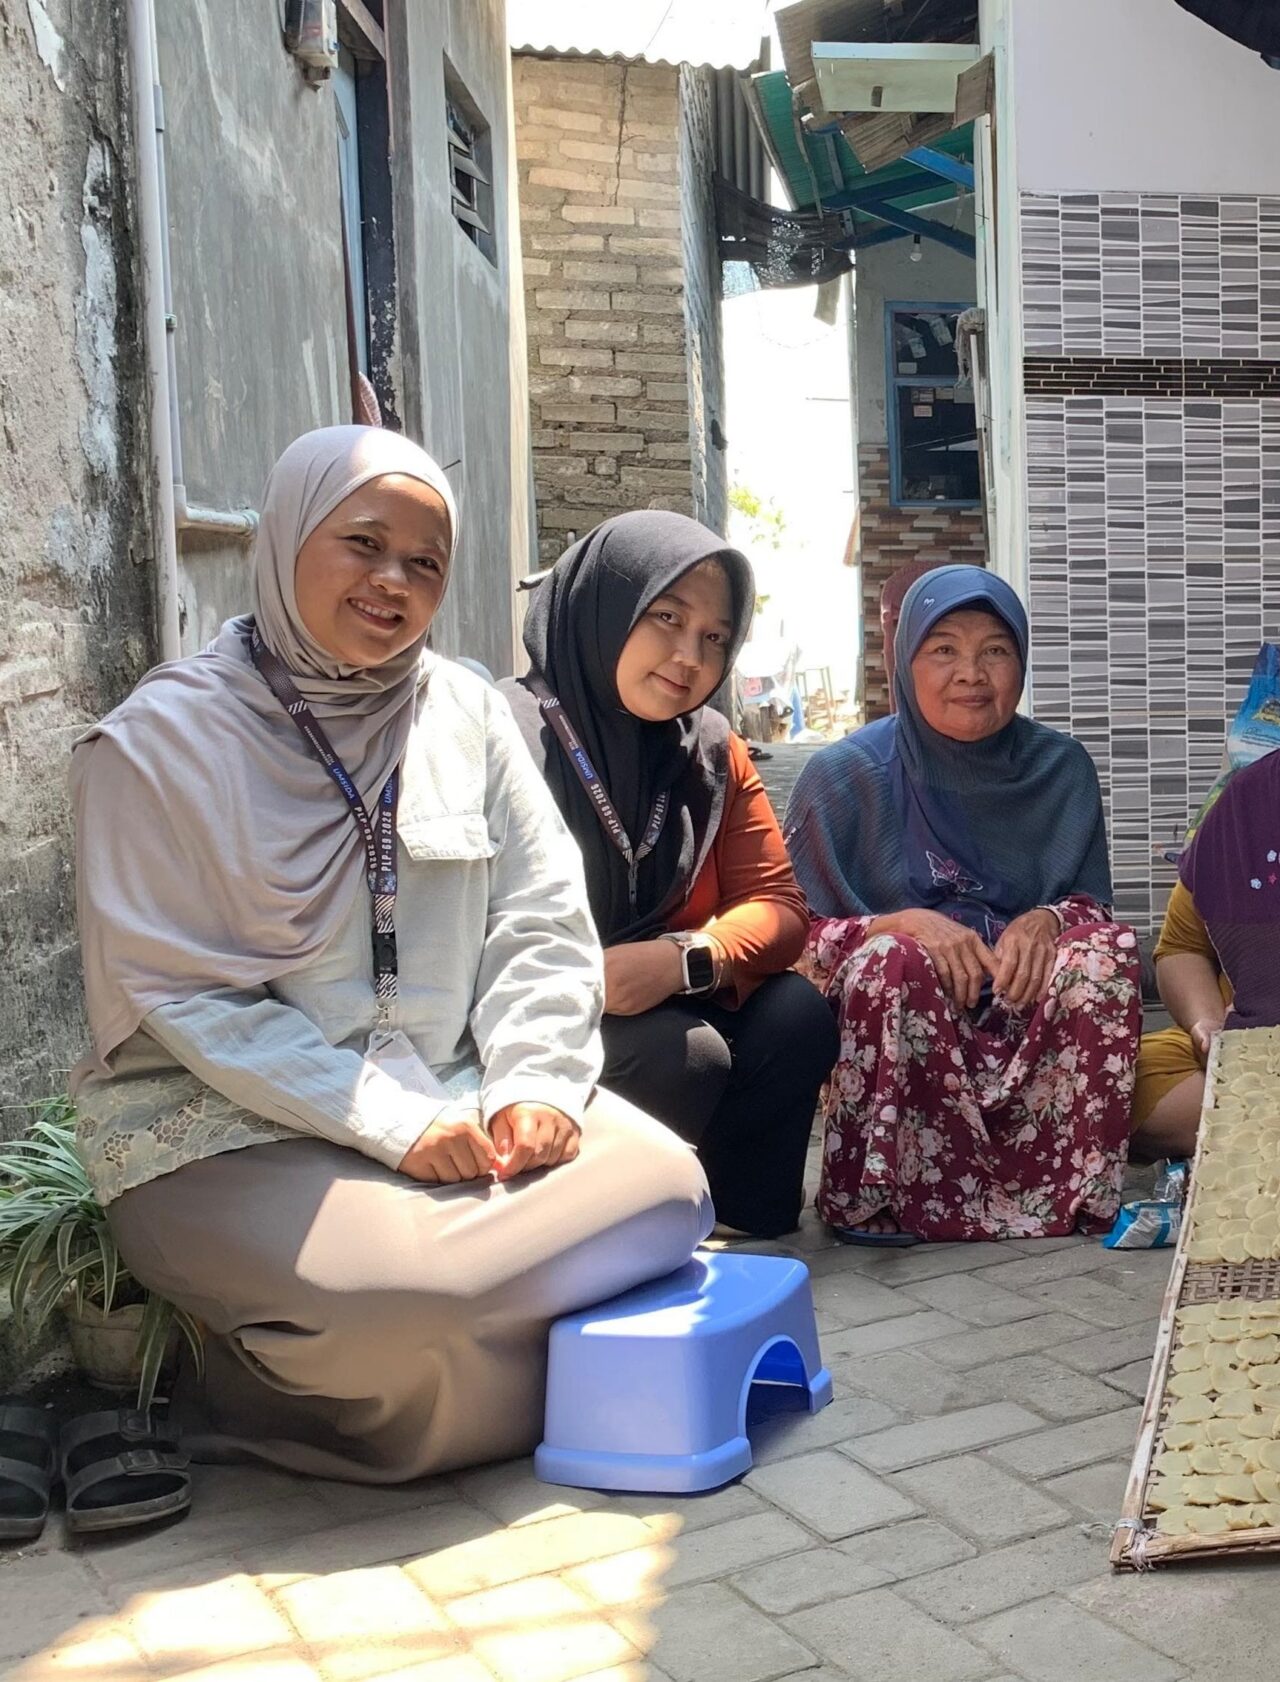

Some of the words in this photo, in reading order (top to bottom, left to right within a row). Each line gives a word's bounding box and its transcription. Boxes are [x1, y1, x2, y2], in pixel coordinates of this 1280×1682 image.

[575, 751, 594, 779] UMSIDA
[333, 768, 355, 799] UMSIDA
[590, 783, 607, 804] 2026
[382, 811, 392, 835] 2026
